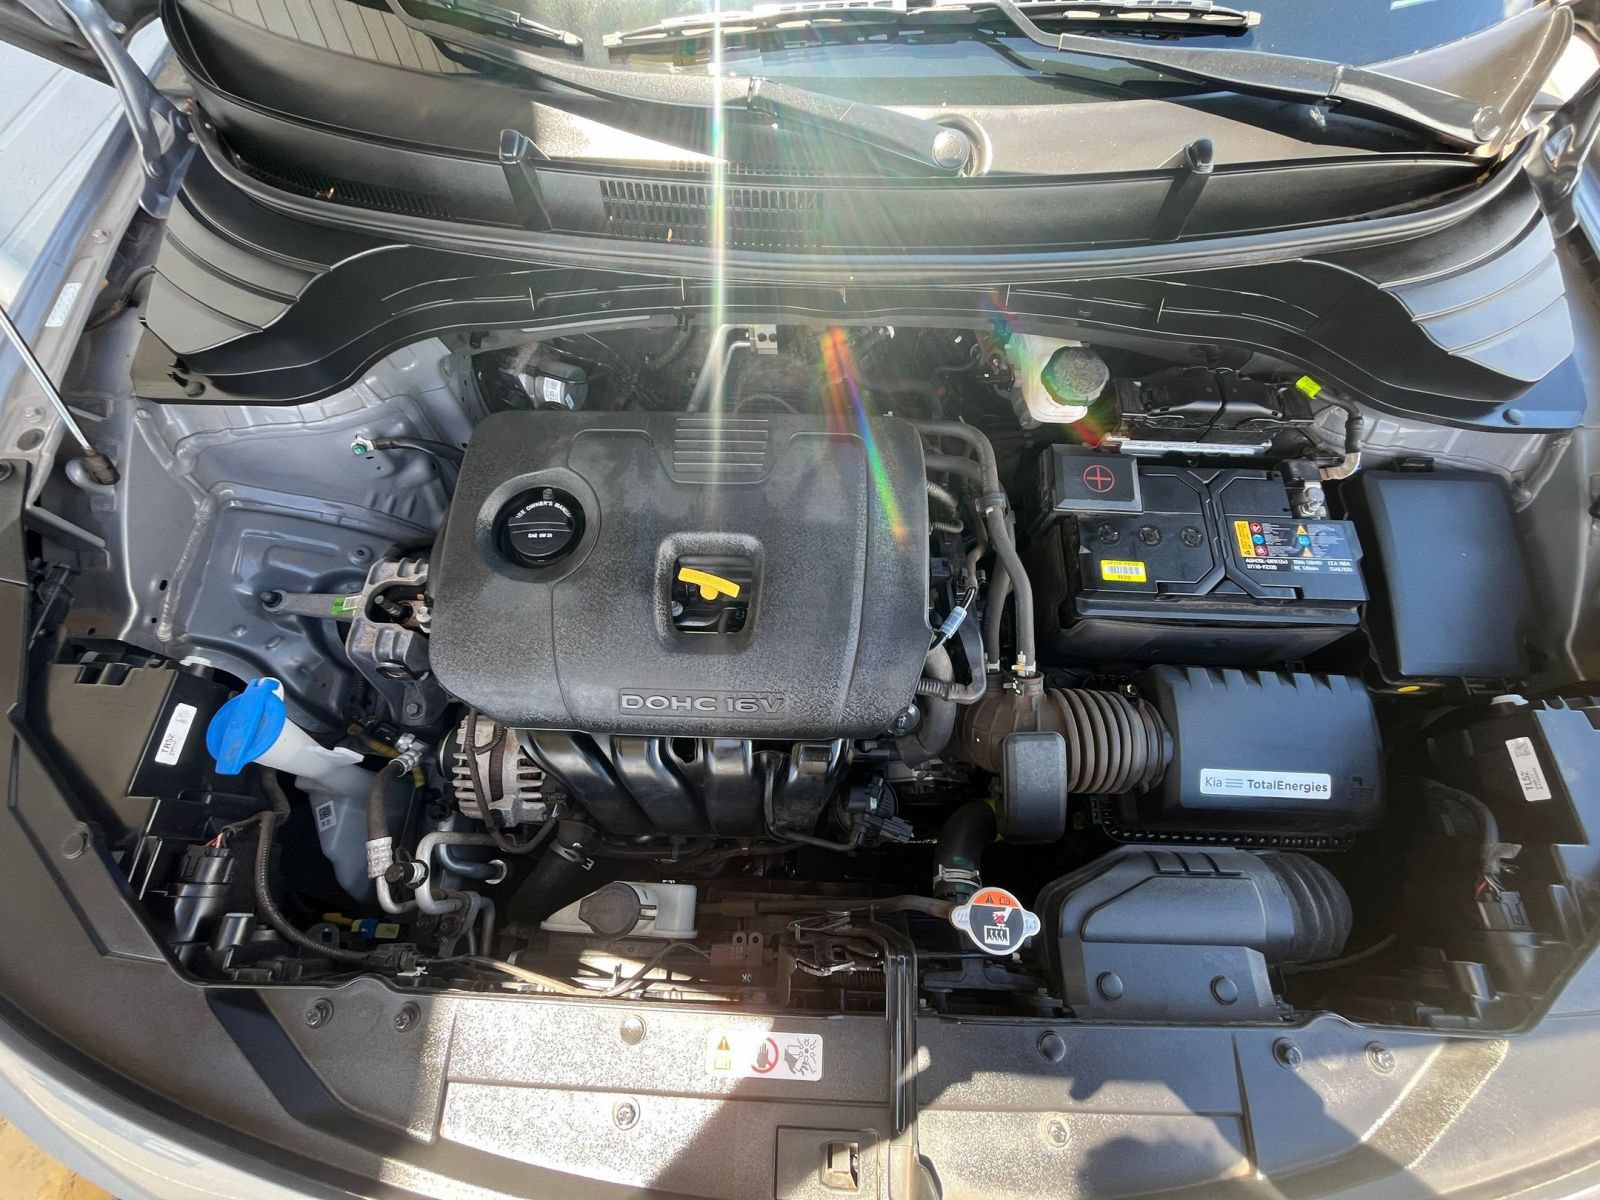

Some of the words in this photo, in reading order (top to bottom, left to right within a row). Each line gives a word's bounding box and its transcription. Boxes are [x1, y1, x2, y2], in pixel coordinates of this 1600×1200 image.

[525, 500, 553, 511] OWNER'S
[621, 693, 717, 711] DOHC
[726, 696, 784, 713] 16V
[1205, 776, 1222, 788] Kia
[1247, 778, 1328, 794] TotalEnergies
